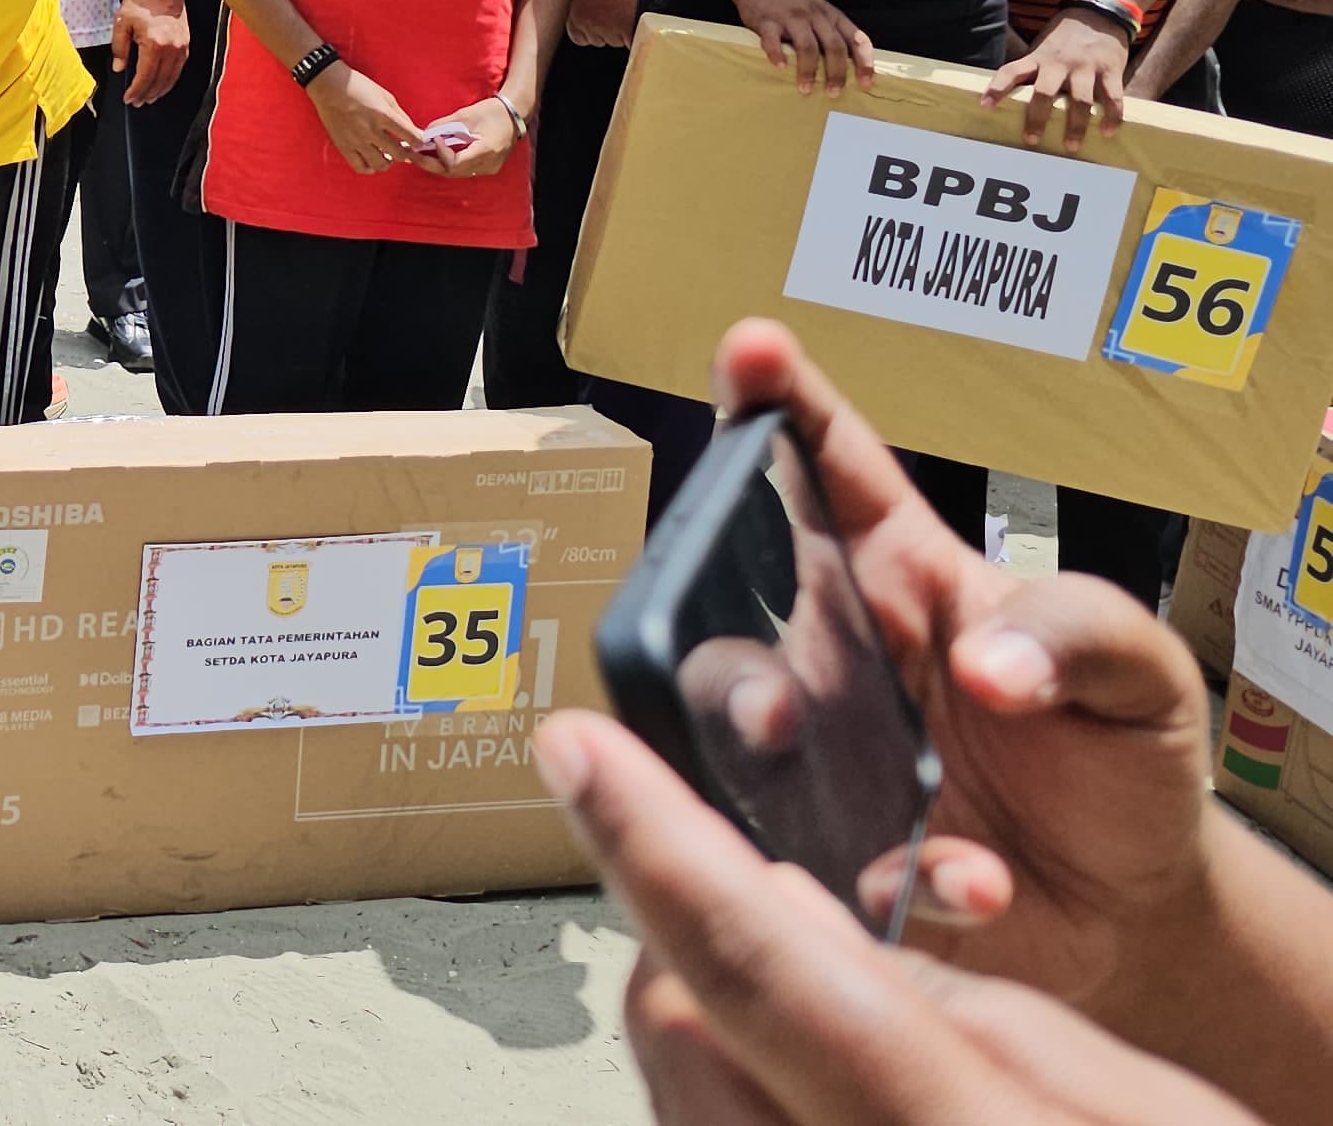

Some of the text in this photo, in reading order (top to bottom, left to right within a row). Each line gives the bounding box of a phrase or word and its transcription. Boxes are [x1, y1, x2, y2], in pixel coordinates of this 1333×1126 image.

[867, 154, 1081, 233] BPBJ
[852, 215, 1059, 321] KOTA JAYAPURA
[1140, 262, 1252, 337] 56
[476, 472, 528, 487] DEPAN
[559, 545, 617, 564] /80cm
[1306, 524, 1333, 584] 5
[12, 609, 138, 643] HD REA
[186, 629, 381, 649] BAGIAN TATA PEMERINTAHAN
[416, 609, 500, 668] 35
[204, 649, 359, 668] SETDA KOTA JAYAPURA
[1294, 637, 1333, 670] JAYAP
[100, 671, 133, 685] Dolb
[11, 709, 53, 722] MEDIA
[102, 706, 131, 721] BEZ
[379, 742, 417, 774] IN
